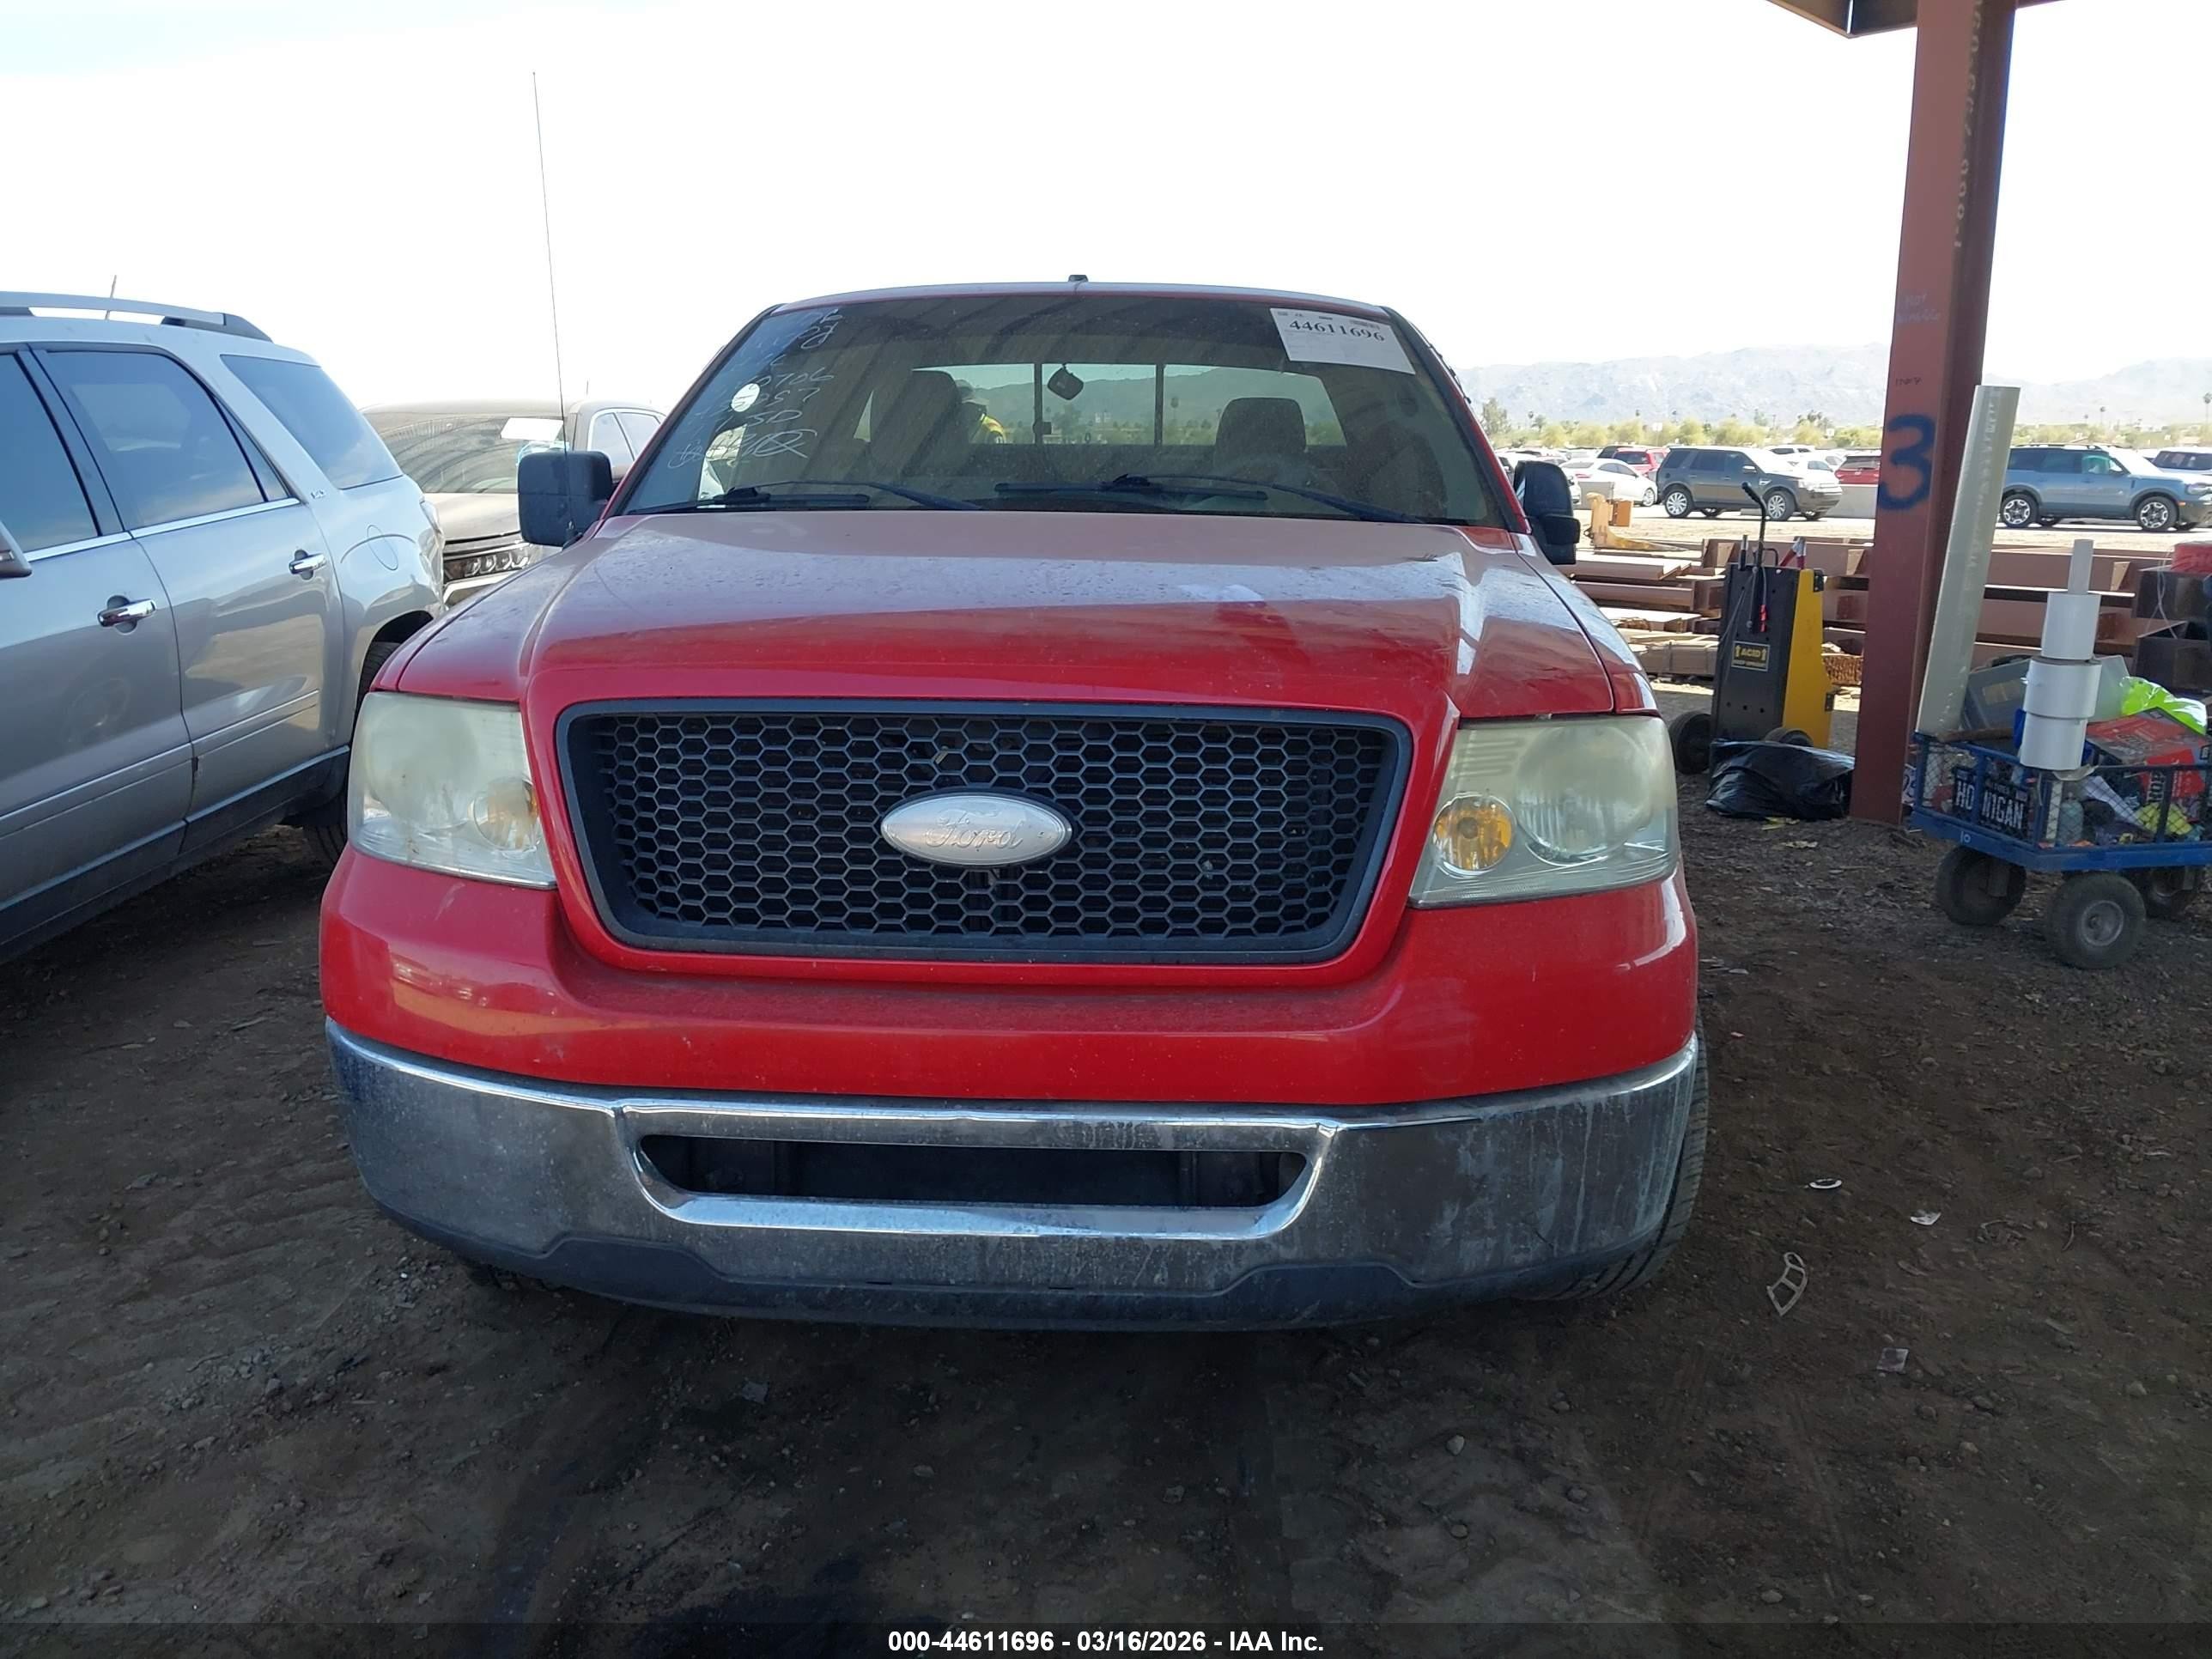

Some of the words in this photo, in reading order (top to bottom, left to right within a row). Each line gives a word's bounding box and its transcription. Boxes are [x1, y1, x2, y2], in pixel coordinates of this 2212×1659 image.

[1289, 319, 1386, 342] 44611696
[1877, 414, 1936, 511] 3
[924, 808, 1027, 849] Ford
